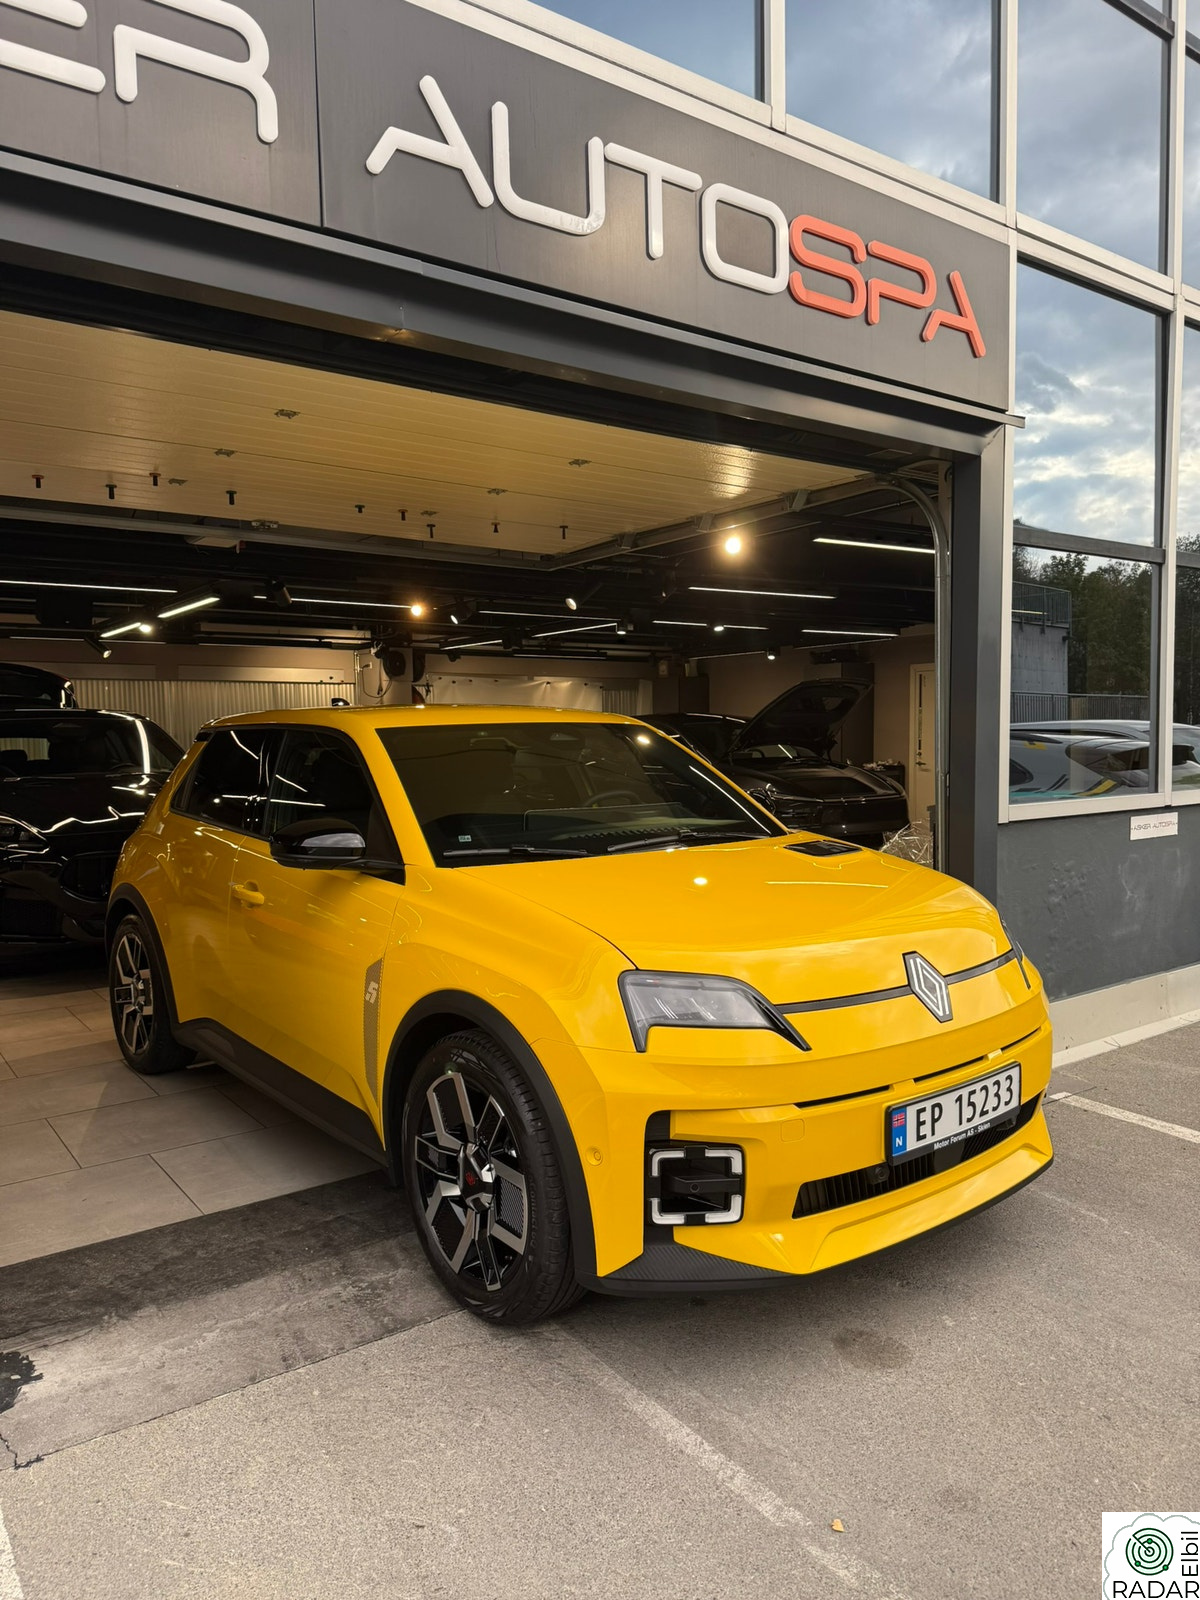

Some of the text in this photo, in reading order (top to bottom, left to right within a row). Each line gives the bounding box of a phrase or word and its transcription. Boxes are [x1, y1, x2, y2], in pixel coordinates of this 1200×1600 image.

[916, 1074, 1014, 1142] EP 15233
[895, 1136, 903, 1148] N
[934, 1139, 950, 1150] Motor
[950, 1133, 967, 1144] Forum
[967, 1128, 974, 1137] AS
[977, 1122, 991, 1133] Skien
